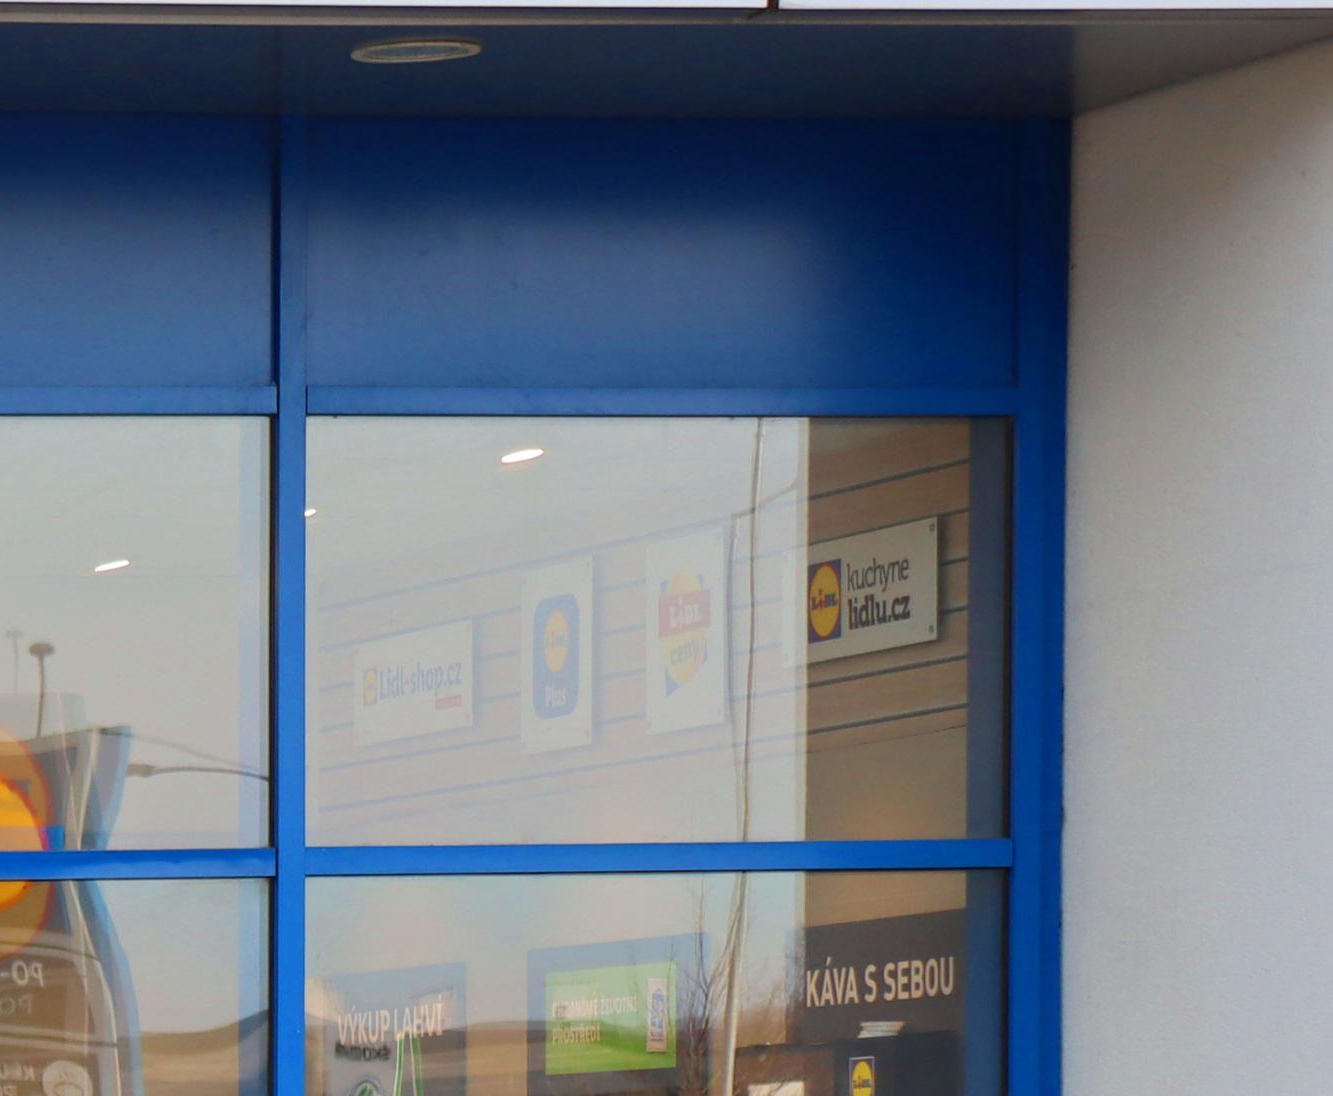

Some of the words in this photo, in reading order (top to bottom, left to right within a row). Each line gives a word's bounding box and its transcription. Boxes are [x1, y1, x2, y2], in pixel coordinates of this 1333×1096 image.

[847, 557, 910, 593] kuchyne
[848, 594, 911, 630] lidlu.cz
[806, 956, 859, 1007] KÁVA
[864, 964, 877, 1003] S
[883, 955, 955, 1001] SEBOU
[337, 1005, 391, 1046] VÝKUP
